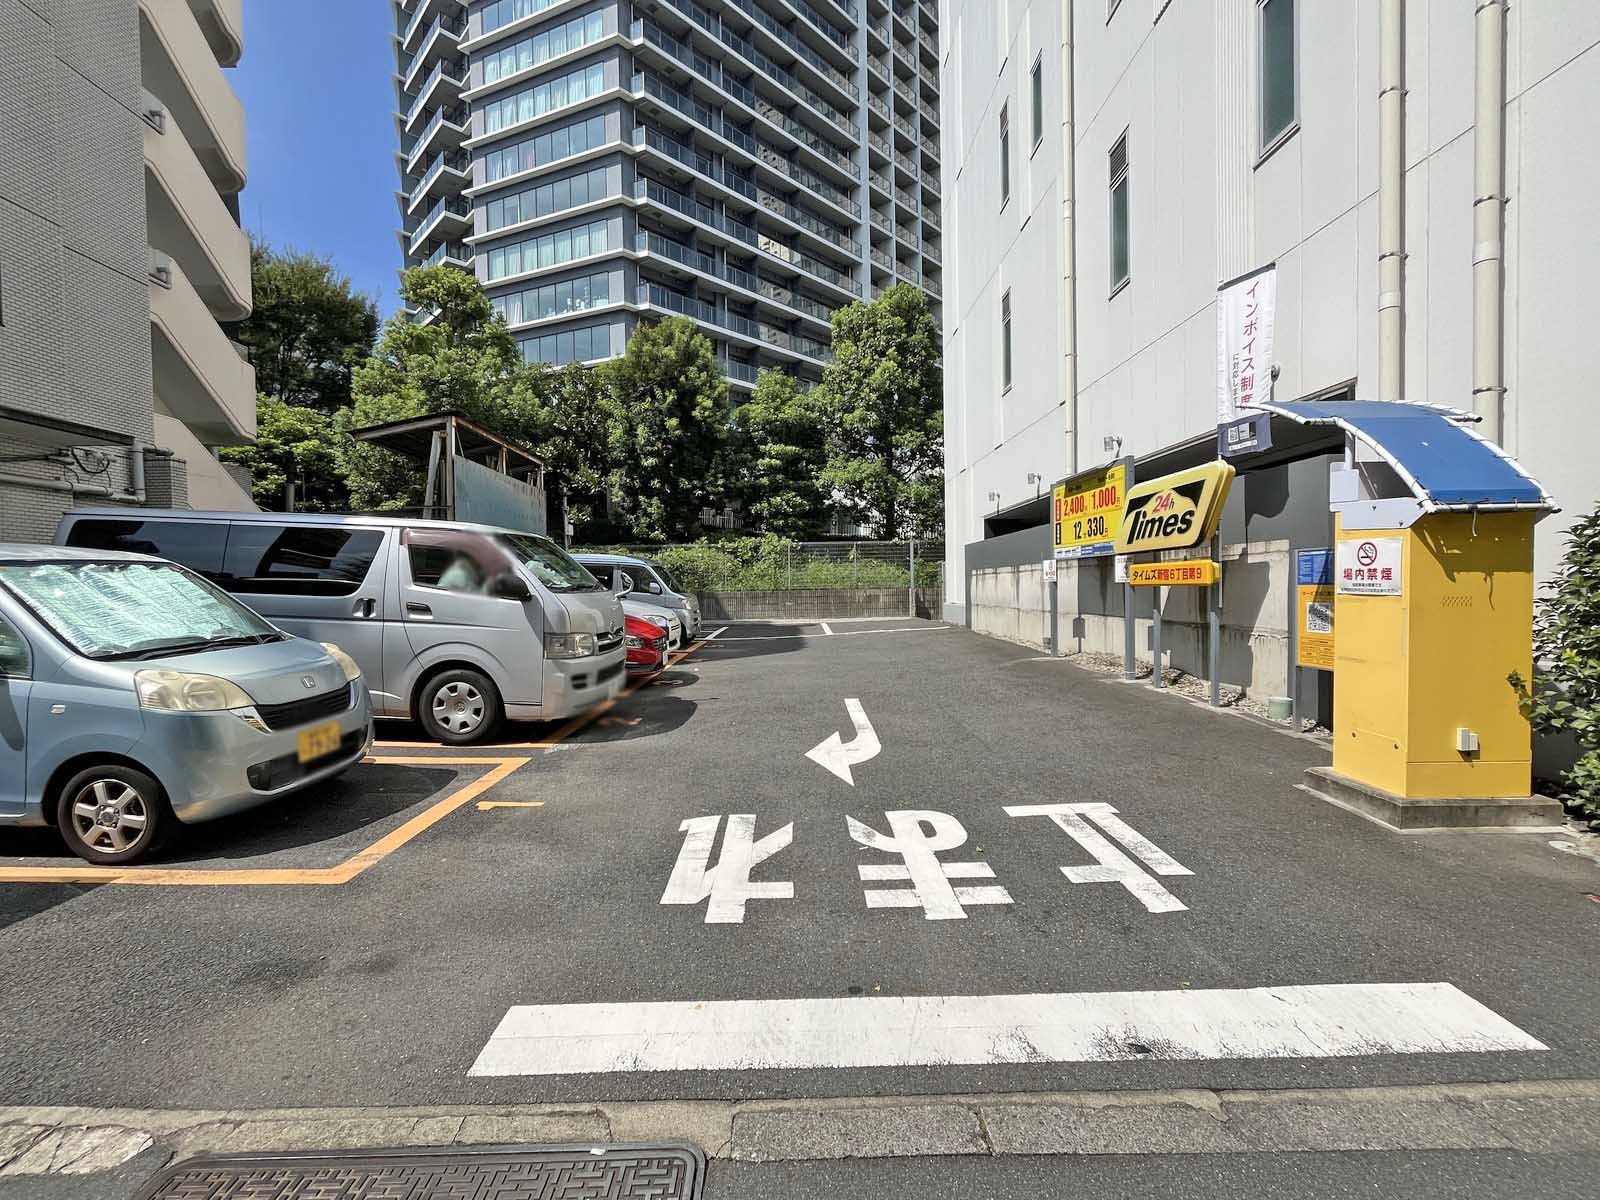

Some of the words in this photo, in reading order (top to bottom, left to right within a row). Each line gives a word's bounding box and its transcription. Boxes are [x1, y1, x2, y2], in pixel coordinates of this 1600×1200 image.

[1152, 492, 1174, 513] 24h
[1127, 509, 1195, 545] Times
[1343, 567, 1393, 581] 場内禁煙
